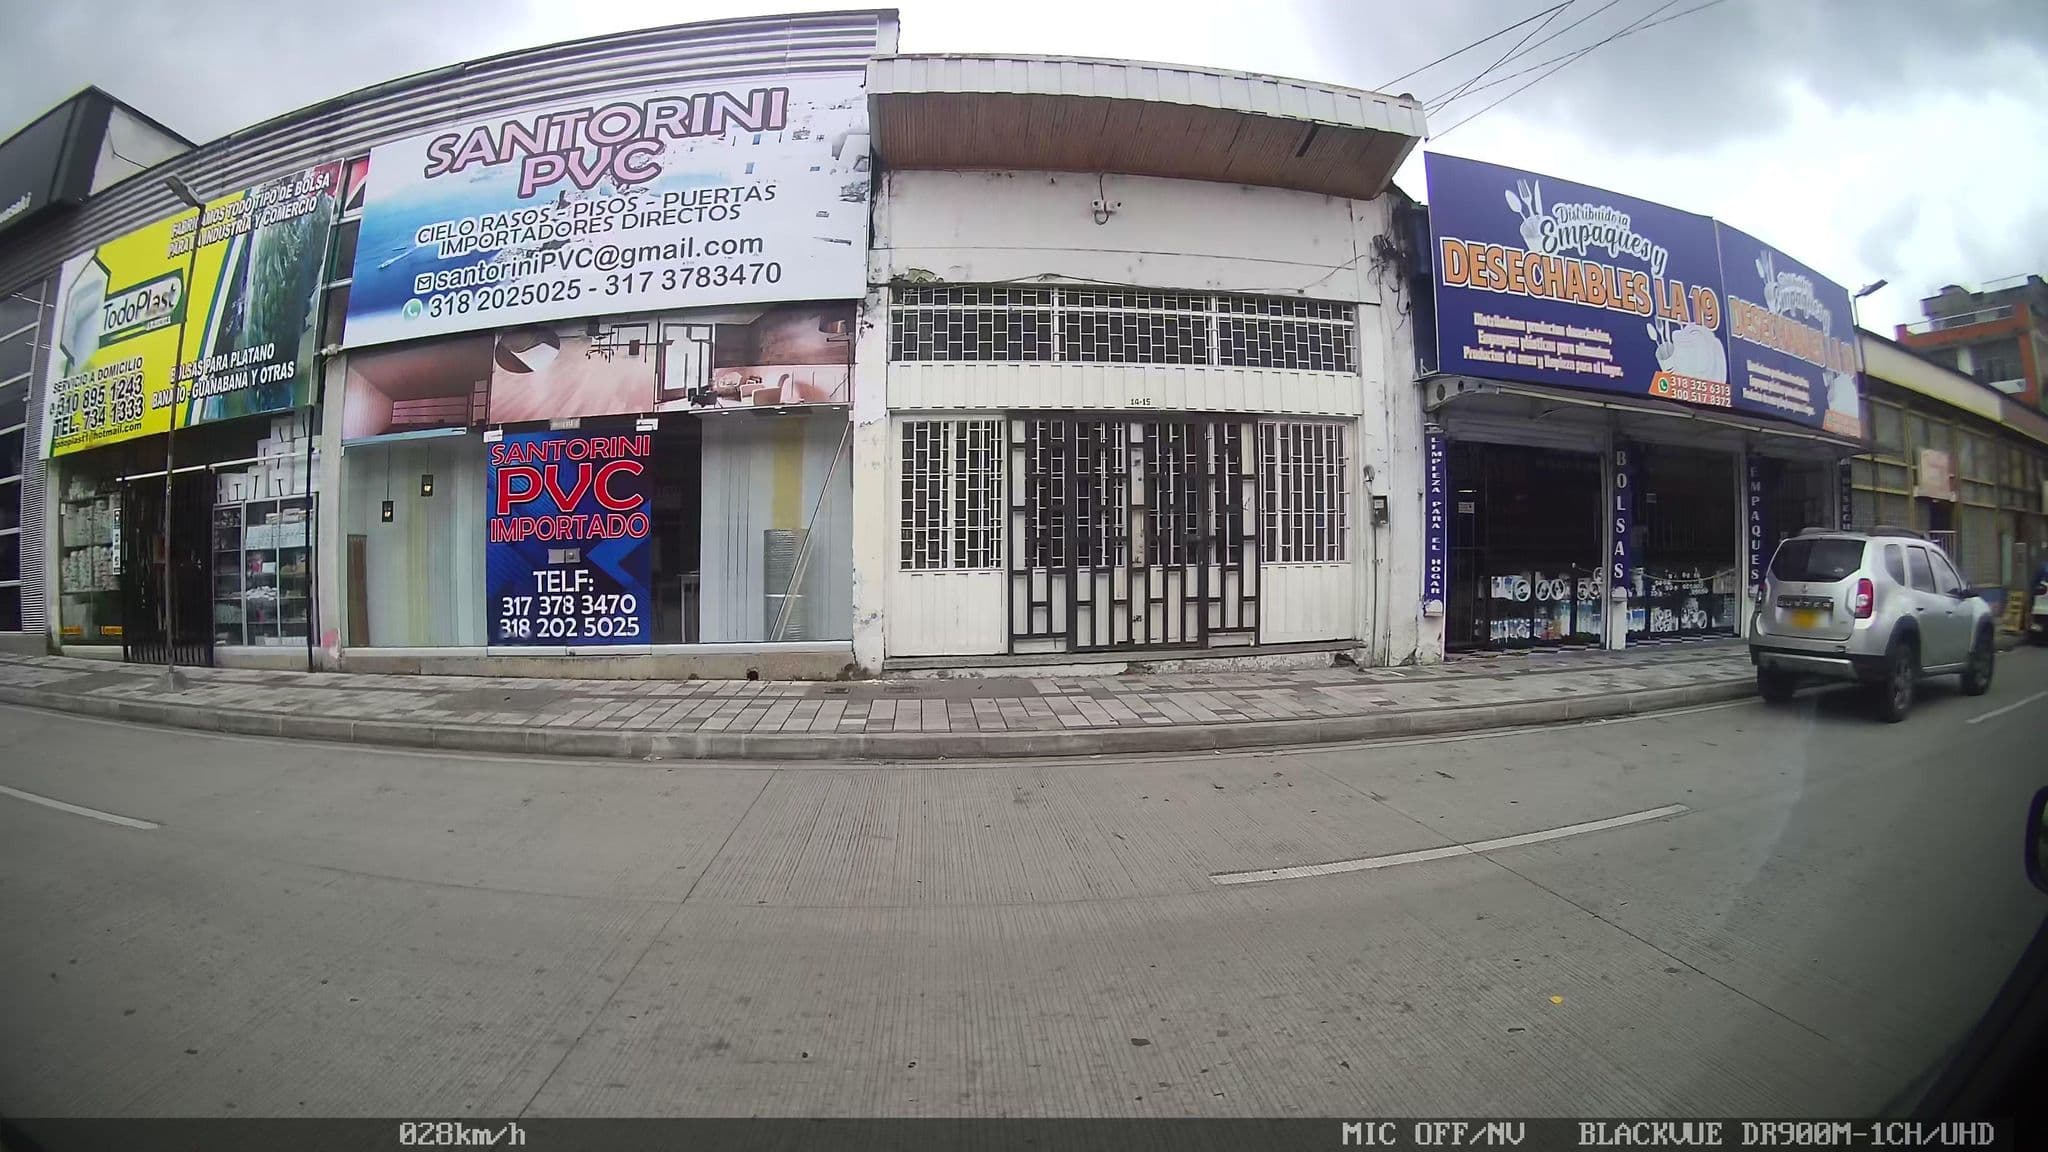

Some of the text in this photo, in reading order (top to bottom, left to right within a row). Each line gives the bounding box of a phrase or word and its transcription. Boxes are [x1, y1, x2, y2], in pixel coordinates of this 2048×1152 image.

[424, 87, 789, 178] SANTORINI
[518, 139, 665, 199] PVC
[226, 197, 252, 220] TODO
[254, 188, 278, 211] TIPO
[278, 183, 294, 199] DE
[294, 172, 330, 195] BOLSA
[417, 220, 475, 244] CIELO
[481, 206, 551, 233] RASOS
[573, 196, 639, 219] PISOS
[662, 184, 777, 209] PUERTAS
[1554, 204, 1629, 227] Distribuidora
[204, 217, 252, 246] INDUSTRIA
[254, 214, 263, 229] Y
[263, 197, 317, 227] COMERCIO
[440, 203, 742, 256] IMPORTADORES DIRECTOS
[1540, 218, 1650, 259] Empaques
[437, 236, 764, 289] santoriniPVC@gmail.com
[430, 293, 470, 318] 318
[477, 278, 582, 311] 2025025
[604, 271, 654, 296] 317
[661, 261, 782, 292] 3783470
[1440, 237, 1720, 331] DESECHABLES LA 19
[98, 357, 143, 381] DOMICILIO
[204, 353, 228, 373] PARA
[230, 343, 275, 368] PLATANO
[82, 385, 106, 409] 895
[110, 374, 143, 401] 1243
[192, 370, 248, 400] GUANABANA
[251, 368, 259, 386] Y
[259, 361, 294, 384] OTRAS
[1670, 375, 1688, 389] 318
[1671, 388, 1689, 401] 300
[55, 396, 144, 437] TEL. 734 1333
[490, 434, 651, 466] SANTORINI
[496, 460, 645, 516] PVC
[490, 512, 650, 543] IMPORTADO
[1430, 437, 1442, 594] LIMPIEZA PARA EL HOGAR
[1614, 450, 1628, 579] BOLSAS
[1750, 466, 1761, 580] EMPAQUES
[532, 569, 594, 593] TELF:
[502, 593, 637, 617] 317 378 3470
[500, 616, 640, 639] 318 202 5025
